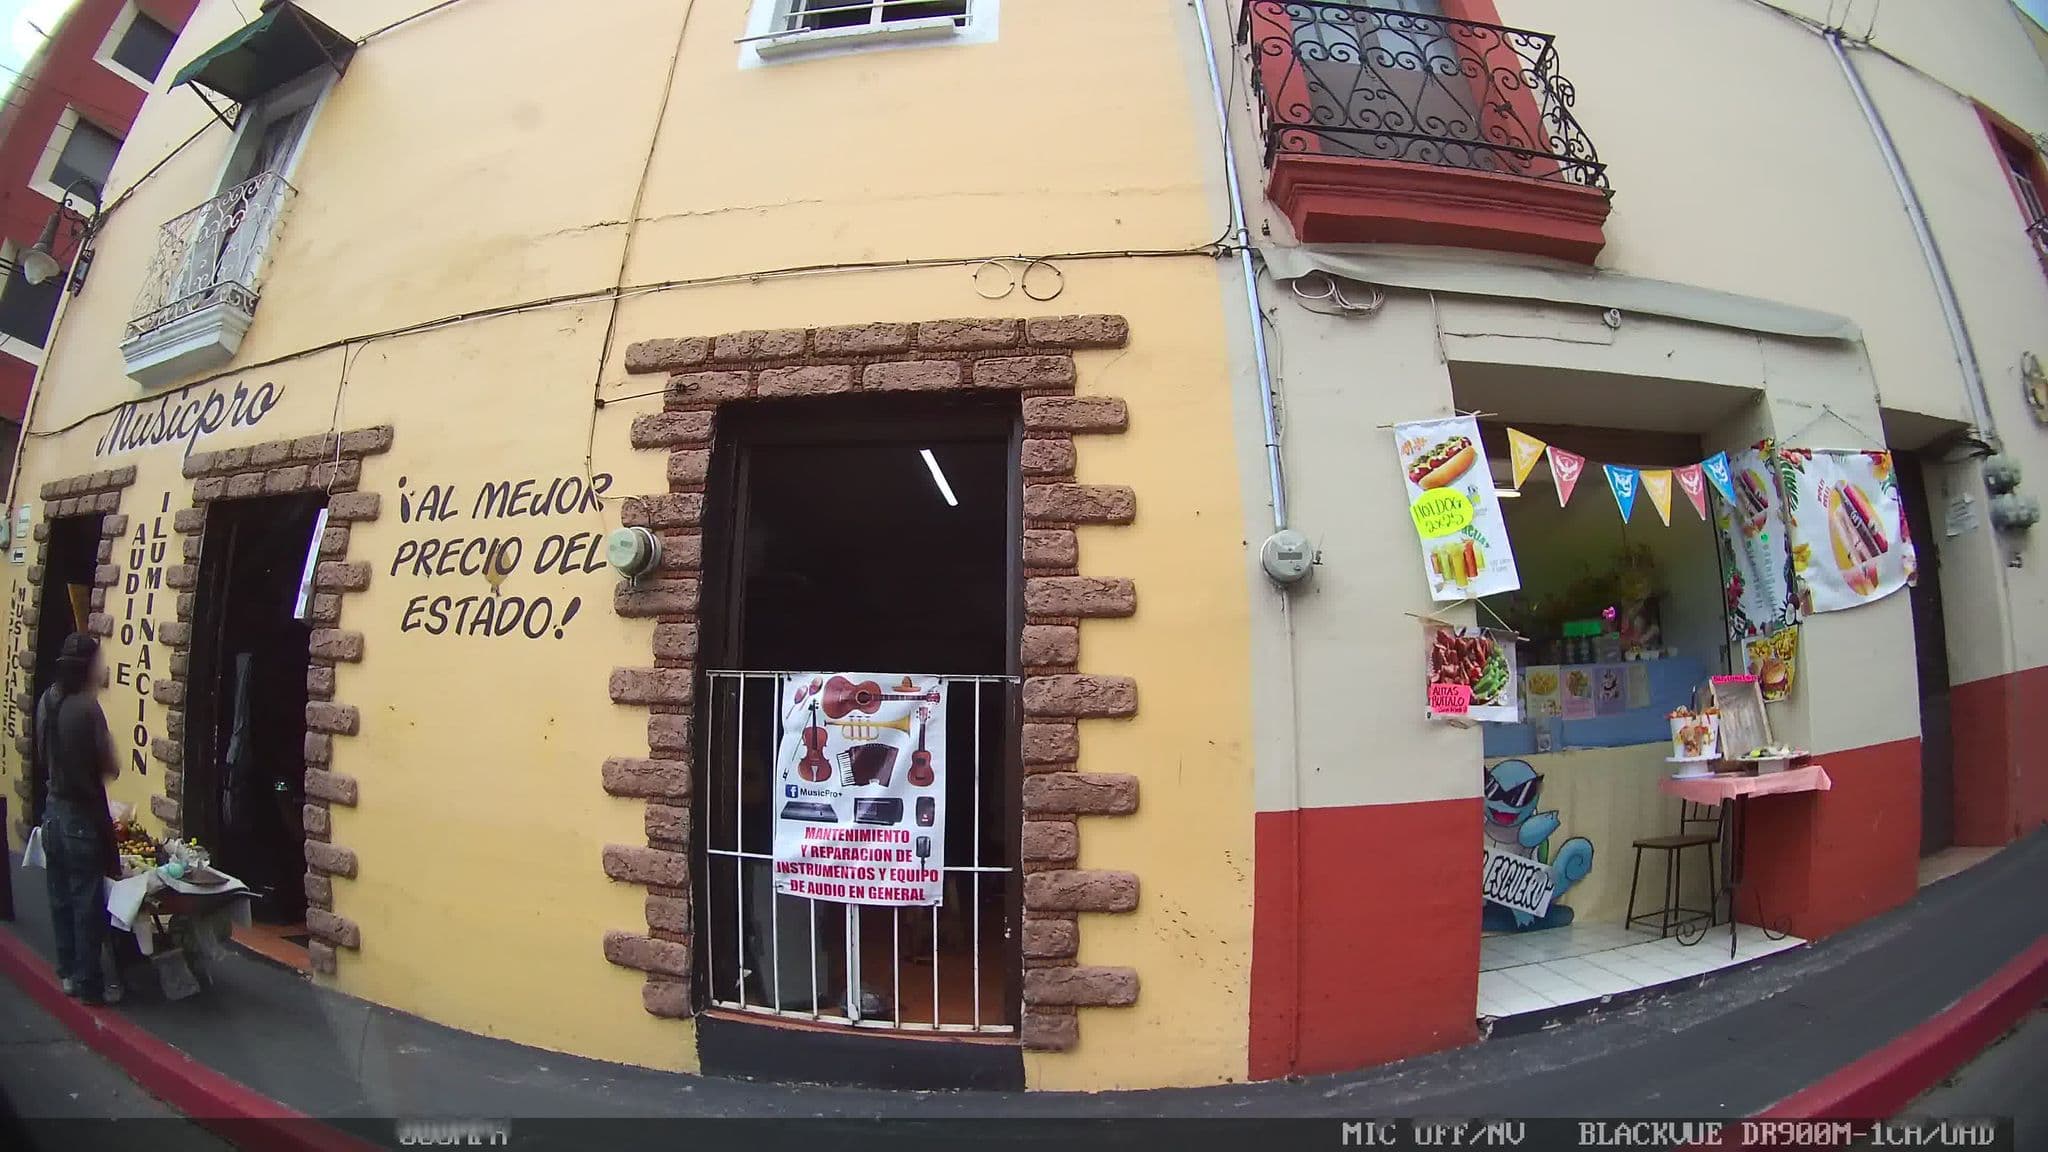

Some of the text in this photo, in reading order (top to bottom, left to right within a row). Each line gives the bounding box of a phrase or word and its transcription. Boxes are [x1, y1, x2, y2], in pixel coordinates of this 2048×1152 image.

[95, 380, 286, 457] Musicpro
[472, 472, 614, 519] MEJOR
[390, 532, 608, 577] PRECIO DEL
[116, 523, 145, 686] AUDIO E
[401, 595, 581, 640] ESTADO!
[131, 492, 170, 776] ILUMINACION
[8, 587, 26, 738] MUSICALES
[801, 844, 913, 862] Y REPARACION DE
[805, 827, 910, 843] MANTENIMIENTO
[777, 862, 938, 882] INSTRUMENTOS Y EQUIPO
[790, 879, 926, 901] DE AUDIO EN GENERAL
